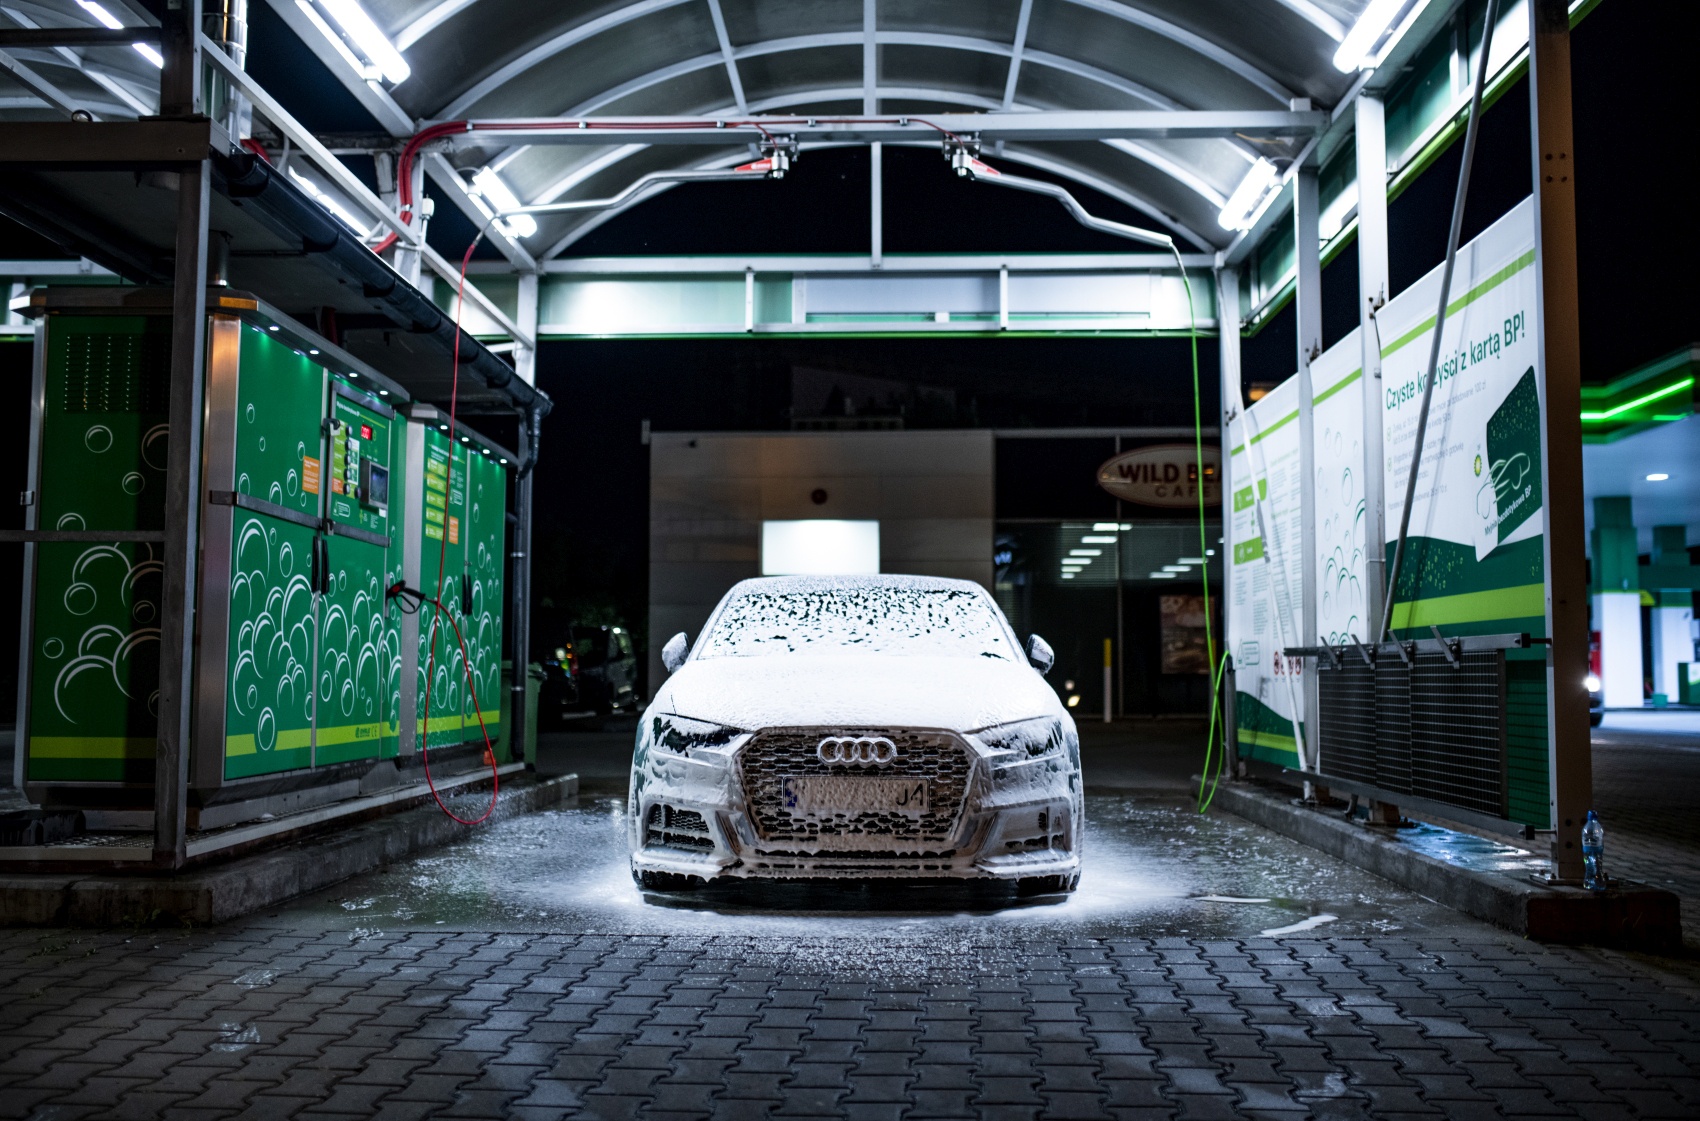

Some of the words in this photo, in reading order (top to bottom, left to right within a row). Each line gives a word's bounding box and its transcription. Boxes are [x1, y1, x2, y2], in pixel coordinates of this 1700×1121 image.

[1386, 380, 1415, 411] Czyste
[1461, 352, 1467, 371] z
[1470, 332, 1501, 366] kartą
[1504, 310, 1525, 348] BP!
[1118, 463, 1180, 484] WILD
